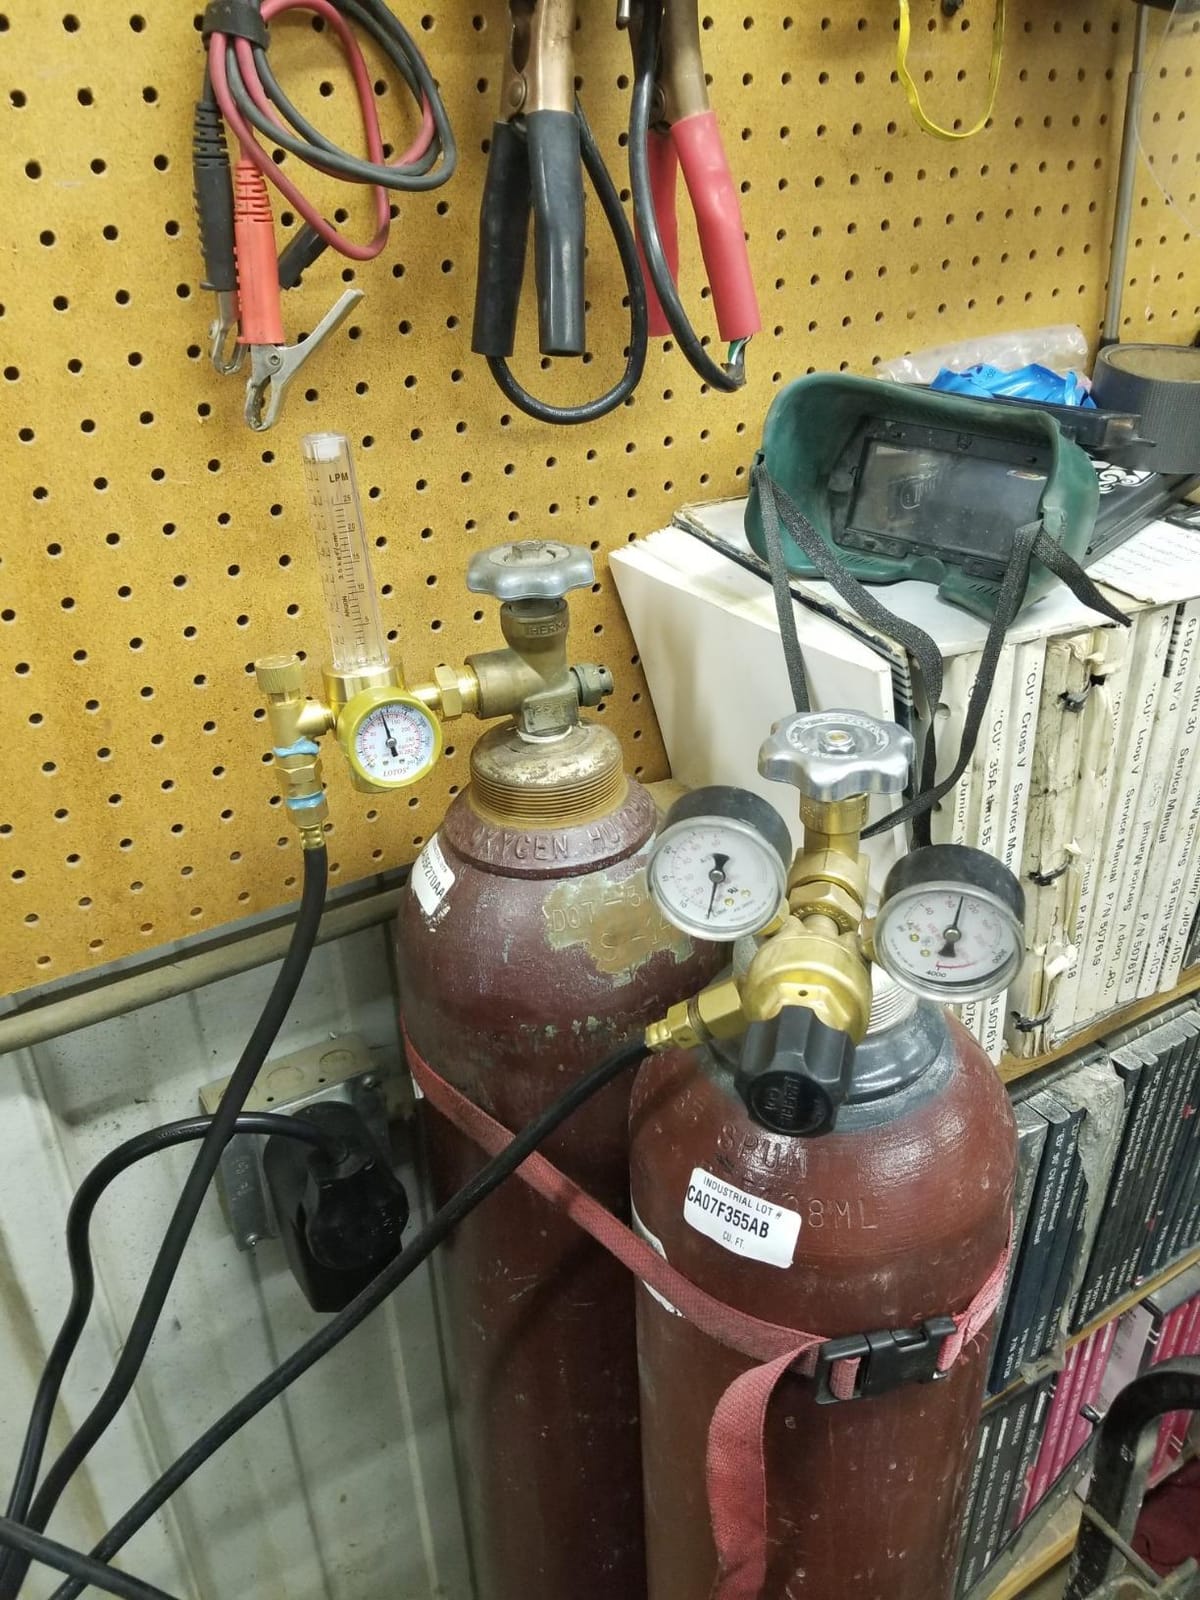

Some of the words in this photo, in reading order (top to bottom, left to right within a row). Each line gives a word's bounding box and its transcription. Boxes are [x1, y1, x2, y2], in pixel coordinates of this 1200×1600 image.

[329, 472, 349, 483] LPM
[1176, 617, 1197, 677] 507619
[1018, 712, 1032, 755] Cross
[1186, 716, 1197, 734] 30
[1133, 728, 1147, 762] Loop
[383, 767, 407, 777] LOTOS
[987, 758, 999, 791] 35A
[1017, 757, 1026, 768] V
[1131, 765, 1140, 774] V
[1170, 747, 1189, 794] Service
[984, 794, 995, 824] thru
[1009, 782, 1023, 834] Service
[1119, 788, 1135, 836] Service
[1159, 798, 1177, 844] Manual
[982, 826, 992, 847] 55
[1005, 836, 1017, 869] Man
[1133, 820, 1151, 866] Manual
[1109, 838, 1125, 883] Manual
[1164, 896, 1176, 921] thru
[1170, 877, 1181, 894] 55
[1177, 822, 1196, 867] Service
[1123, 868, 1140, 911] Service
[1120, 923, 1128, 932] V
[1113, 935, 1126, 962] Loop
[926, 969, 947, 978] 4000
[985, 1008, 1000, 1053] 507618
[687, 1184, 771, 1239] CA07F355AB
[703, 1176, 753, 1209] INDUSTRIAL
[755, 1202, 775, 1217] LOT
[1040, 1182, 1053, 1213] Service
[1033, 1213, 1046, 1245] Manual
